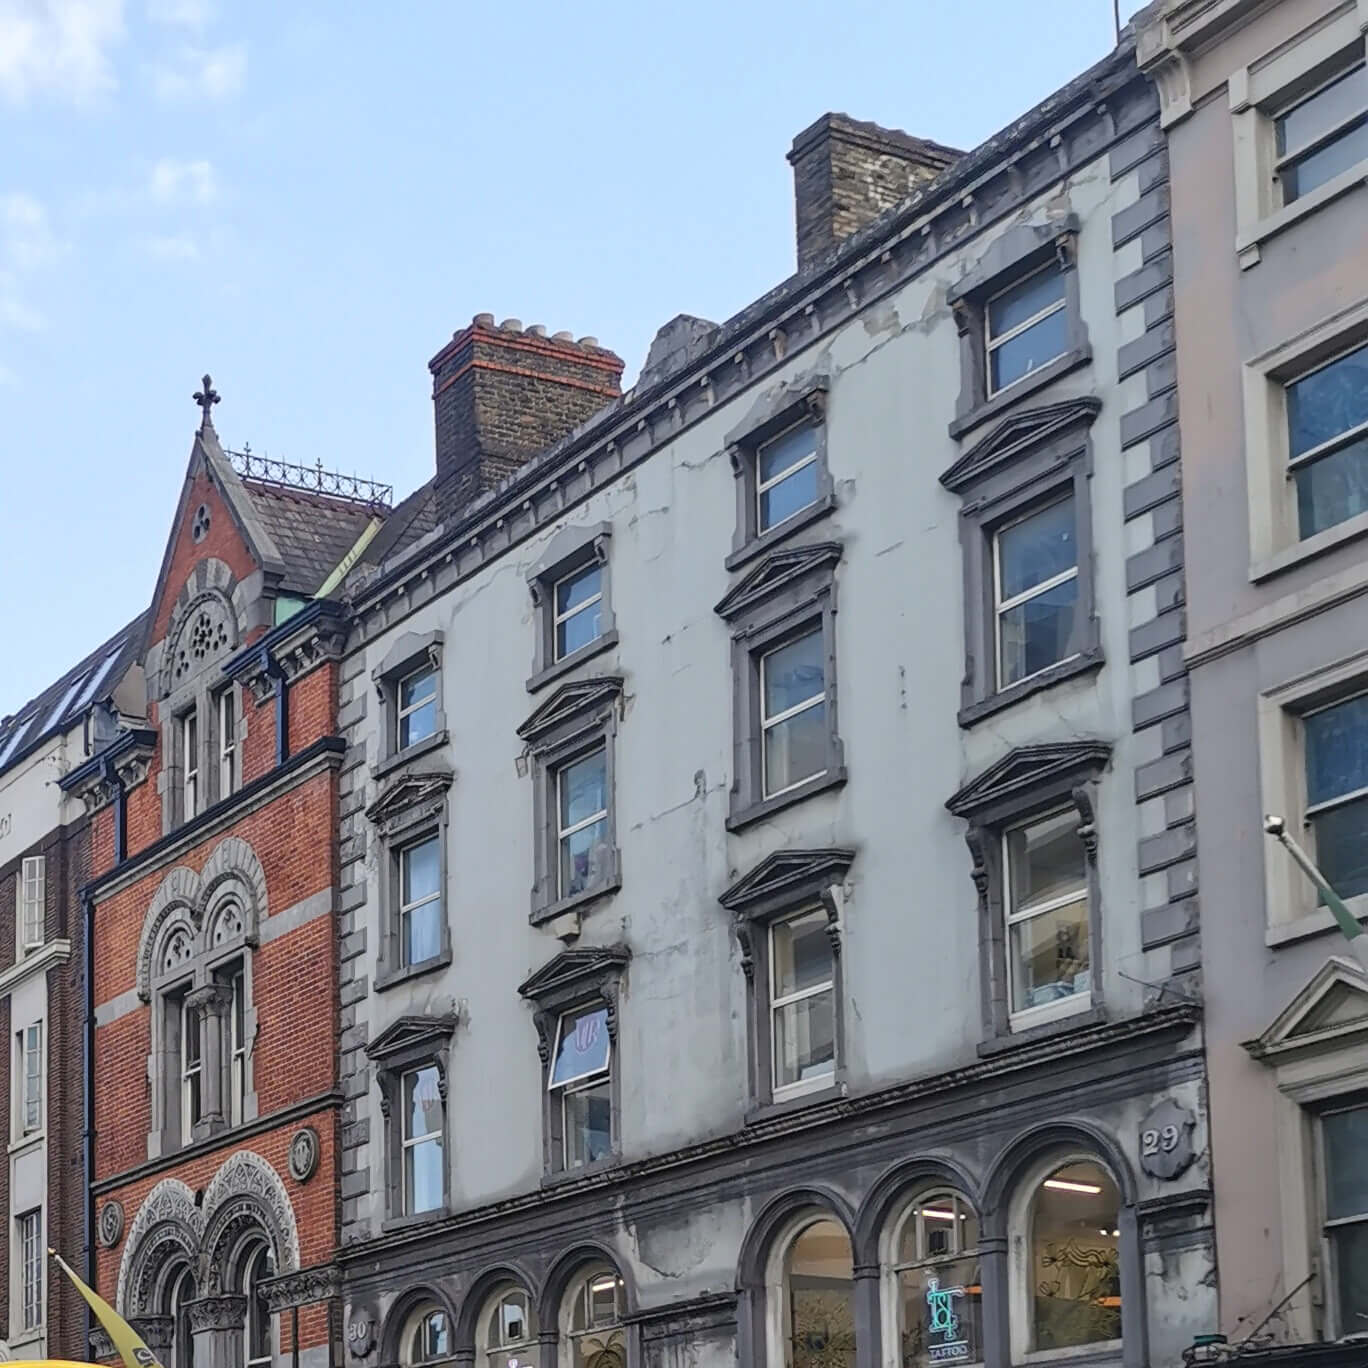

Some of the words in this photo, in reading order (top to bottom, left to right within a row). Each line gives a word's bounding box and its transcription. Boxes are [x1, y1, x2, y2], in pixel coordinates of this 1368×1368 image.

[1143, 1125, 1177, 1154] 29
[348, 1320, 366, 1341] 30
[930, 1345, 968, 1359] TATTOO
